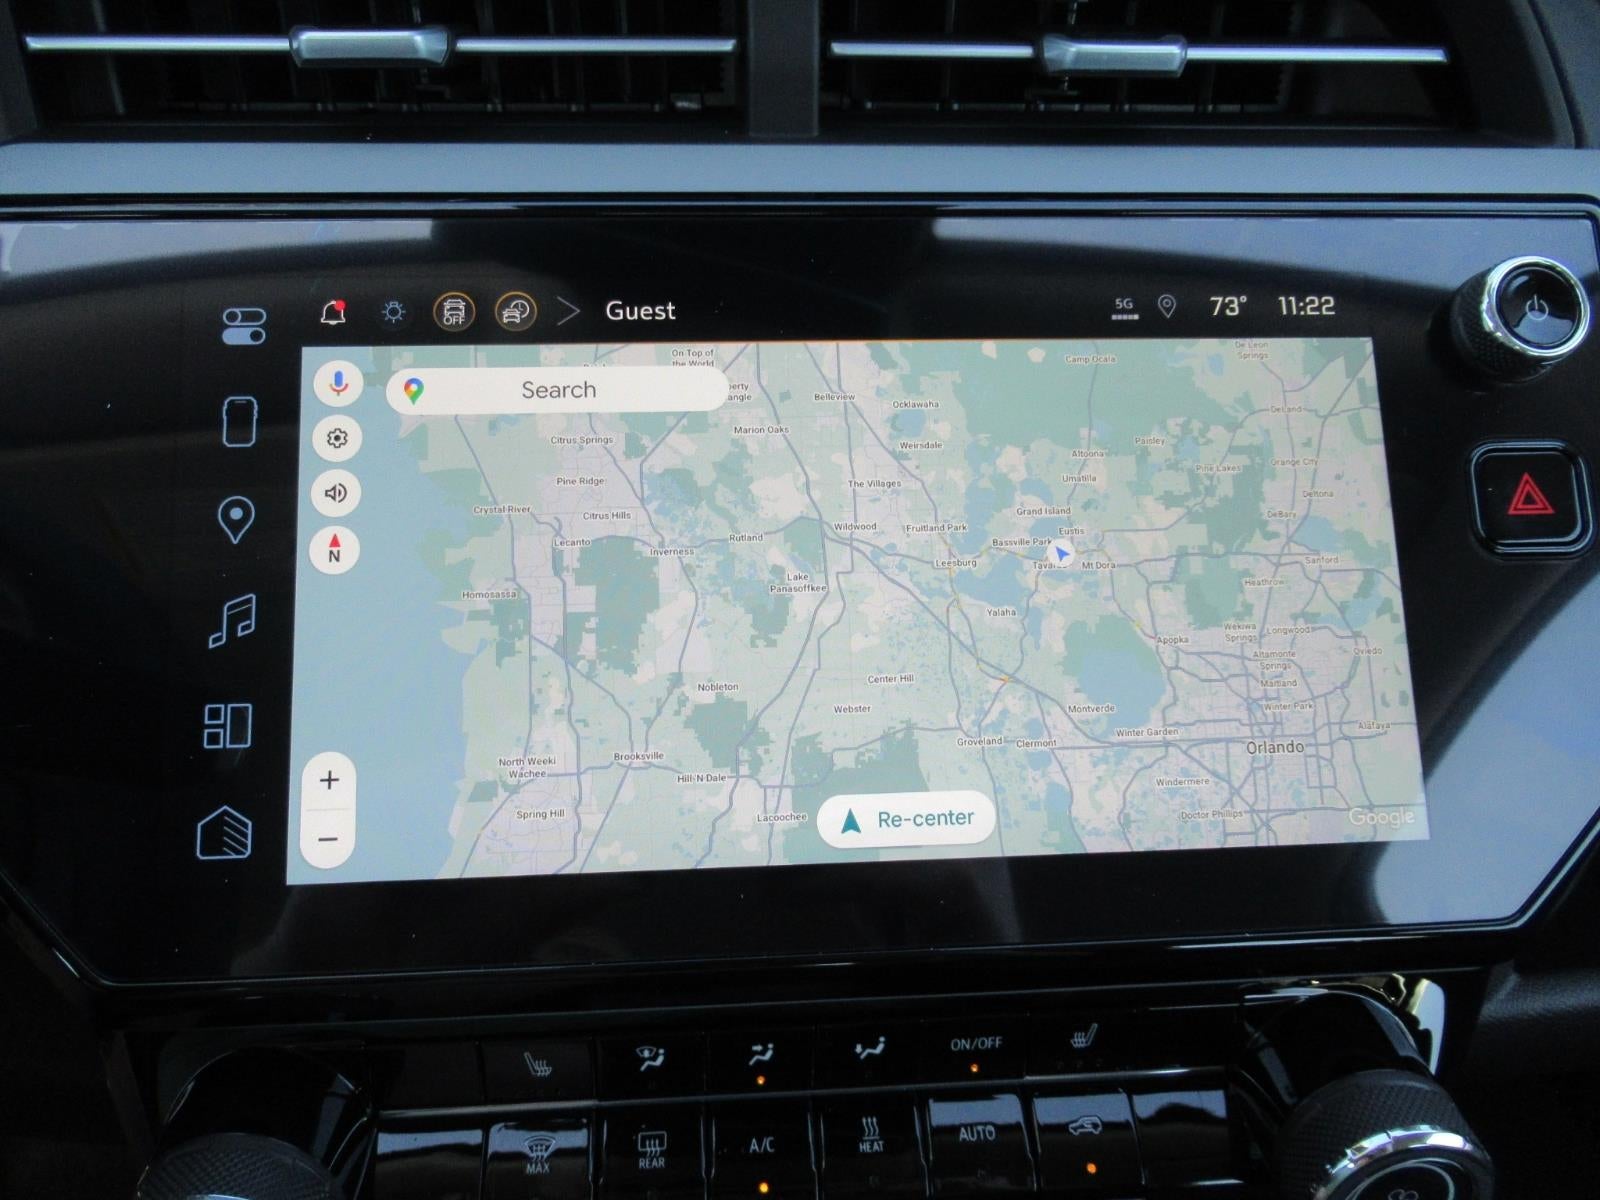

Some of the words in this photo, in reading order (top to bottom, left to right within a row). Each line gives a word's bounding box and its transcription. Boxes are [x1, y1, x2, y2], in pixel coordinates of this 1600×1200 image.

[1115, 298, 1134, 310] 5G
[1210, 295, 1248, 317] 73°
[1278, 295, 1336, 316] 11:22
[606, 300, 676, 320] Guest
[443, 315, 465, 326] OFF
[671, 349, 685, 357] On
[687, 349, 703, 358] Top
[705, 348, 714, 357] of
[1065, 353, 1090, 364] Camp
[1092, 353, 1116, 363] Ocala
[521, 381, 597, 399] Search
[814, 391, 856, 402] Belleview
[892, 399, 940, 410] Ocklawaha
[734, 425, 765, 435] Marion
[768, 425, 790, 435] Oaks
[551, 435, 577, 445] Citrus
[578, 435, 614, 447] Springs
[900, 440, 943, 451] Weirsdale
[1135, 436, 1165, 448] Paisley
[1072, 449, 1105, 459] Altoona
[1270, 457, 1300, 468] Orange
[1302, 456, 1319, 468] City
[1196, 463, 1214, 473] Pine
[1216, 463, 1242, 473] Lakes
[557, 477, 577, 487] Pine
[580, 476, 605, 489] Ridge
[1062, 474, 1097, 484] Umatilla
[848, 479, 866, 489] The
[868, 479, 902, 491] Villages
[1303, 489, 1334, 499] Deltona
[473, 504, 505, 516] Crystal
[506, 504, 531, 514] River
[583, 511, 608, 521] Citrus
[611, 510, 632, 521] Hills
[1016, 507, 1043, 517] Grand
[1044, 506, 1071, 516] Island
[1267, 509, 1297, 520] DeBary
[834, 522, 877, 532] Wildwood
[906, 523, 945, 534] Fruitland
[947, 522, 968, 533] Park
[1058, 526, 1085, 536] Eustis
[554, 537, 592, 547] Lecanto
[729, 533, 764, 543] Rutland
[992, 537, 1031, 547] Bassville
[1032, 536, 1052, 546] Park
[329, 550, 341, 563] N
[649, 547, 695, 558] Inverness
[935, 557, 977, 570] Leesburg
[1082, 561, 1094, 570] Mt
[1096, 560, 1116, 570] Dora
[1305, 554, 1339, 565] Sanford
[787, 573, 809, 582] Lake
[1244, 577, 1284, 587] Heathrow
[462, 589, 517, 599] Homosassa
[770, 583, 828, 594] Panasoffkee
[986, 607, 1017, 618] Yalaha
[1224, 622, 1257, 631] Wekiwa
[1267, 625, 1311, 635] Longwood
[1156, 635, 1190, 646] Apopka
[1225, 633, 1258, 643] Springs
[1253, 650, 1297, 659] Altamonte
[1353, 646, 1383, 656] Oviedo
[1260, 661, 1292, 672] Springs
[867, 674, 897, 684] Center
[899, 673, 914, 684] Hill
[697, 681, 739, 692] Nobleton
[833, 703, 871, 714] Webster
[1068, 702, 1116, 714] Montverde
[1264, 701, 1291, 711] Winter
[1294, 700, 1314, 710] Park
[1358, 720, 1391, 731] Alafaya
[1116, 727, 1144, 738] Winter
[1147, 726, 1179, 737] Garden
[957, 735, 1003, 746] Groveland
[1016, 738, 1057, 749] Clermont
[1246, 739, 1305, 755] Orlando
[498, 756, 525, 767] North
[527, 755, 557, 766] Weeki
[614, 750, 664, 762] Brooksville
[508, 768, 547, 779] Wachee
[1155, 777, 1210, 787] Windermere
[516, 808, 548, 820] Spring
[549, 808, 566, 819] Hill
[757, 812, 807, 823] Lacoochee
[878, 807, 976, 829] Re-center
[1180, 810, 1209, 821] Doctor
[1211, 809, 1244, 821] Phillips
[1349, 808, 1415, 828] Google
[950, 1036, 1003, 1051] ON/OFF
[958, 1125, 996, 1143] AUTO
[749, 1136, 775, 1154] A/C
[859, 1141, 885, 1154] HEAT
[526, 1160, 550, 1174] MAX
[638, 1157, 666, 1169] REAR
